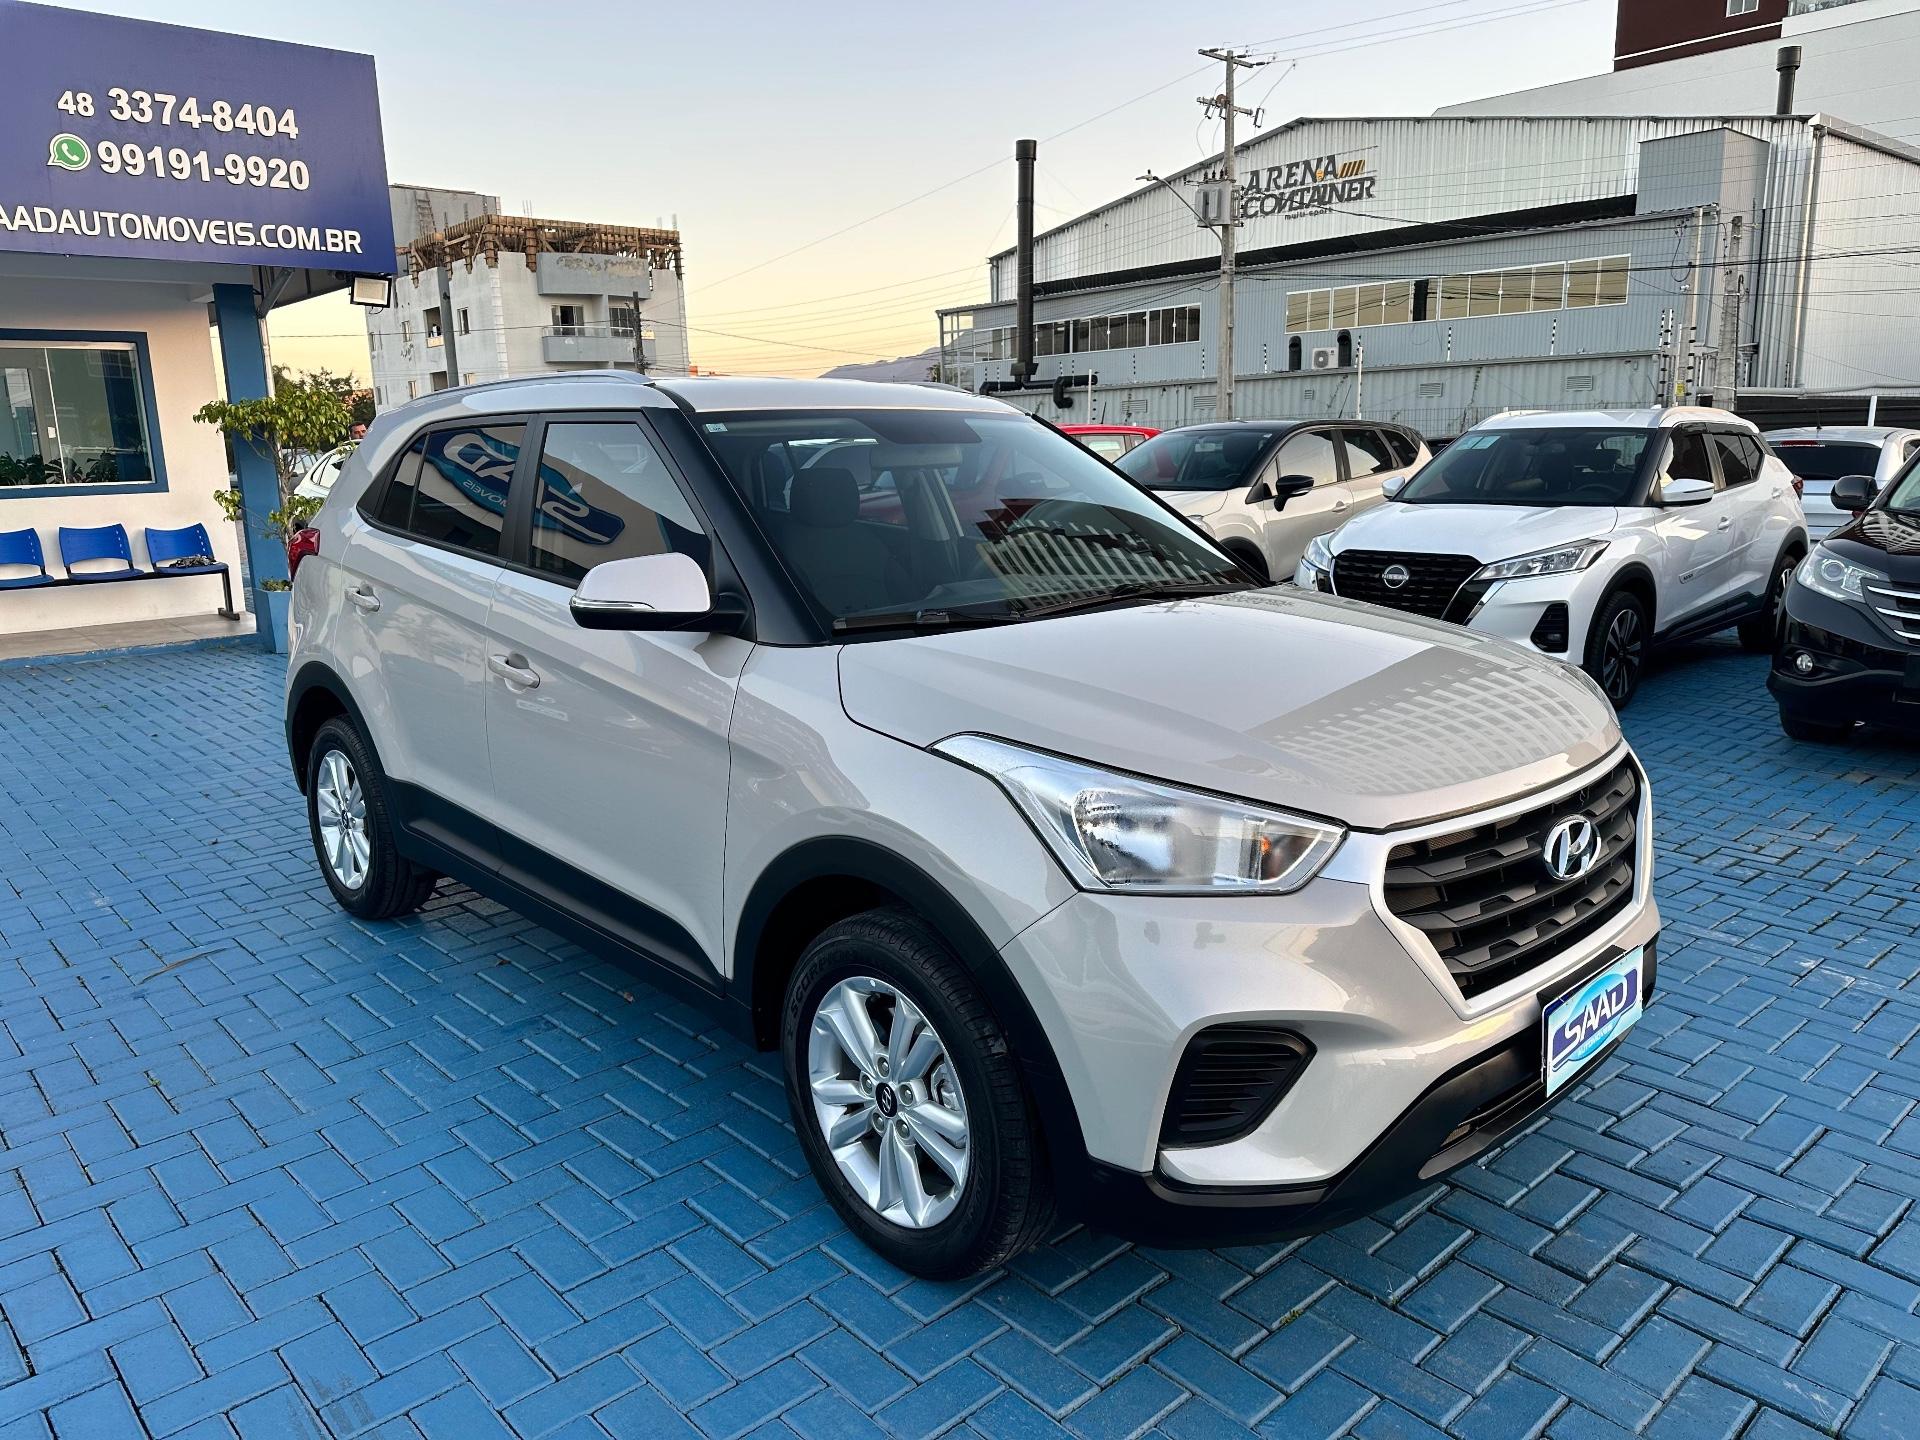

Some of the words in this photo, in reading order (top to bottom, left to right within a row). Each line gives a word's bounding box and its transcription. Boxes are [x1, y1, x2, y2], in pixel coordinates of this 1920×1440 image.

[57, 90, 95, 117] 48
[107, 88, 299, 139] 3374-8404
[97, 140, 310, 190] 99191-9920
[1245, 154, 1338, 195] ARENA
[1243, 176, 1377, 218] CONTAINER
[1556, 976, 1629, 1055] SAAD
